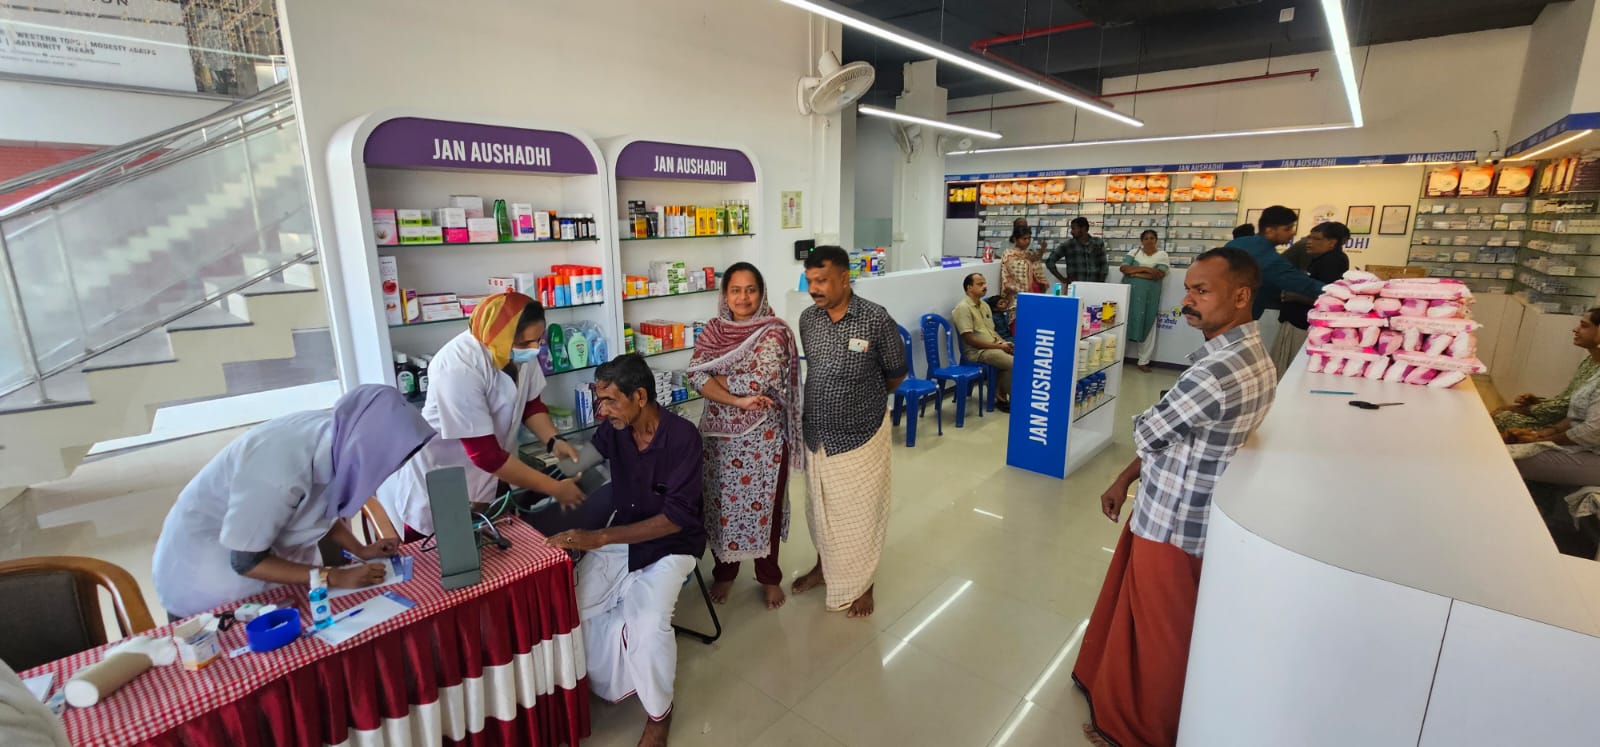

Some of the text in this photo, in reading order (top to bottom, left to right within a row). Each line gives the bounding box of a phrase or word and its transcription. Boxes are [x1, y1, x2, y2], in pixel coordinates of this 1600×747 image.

[16, 31, 57, 42] WESTERN
[90, 41, 126, 52] MODESTY
[433, 138, 551, 167] JAN AUSHADHI
[1280, 158, 1337, 168] JAN AUSHADHI
[1407, 151, 1475, 163] JAN AUSHADHI
[653, 155, 727, 176] JAN AUSHADHI
[1029, 328, 1055, 445] JAN AUSHADHI
